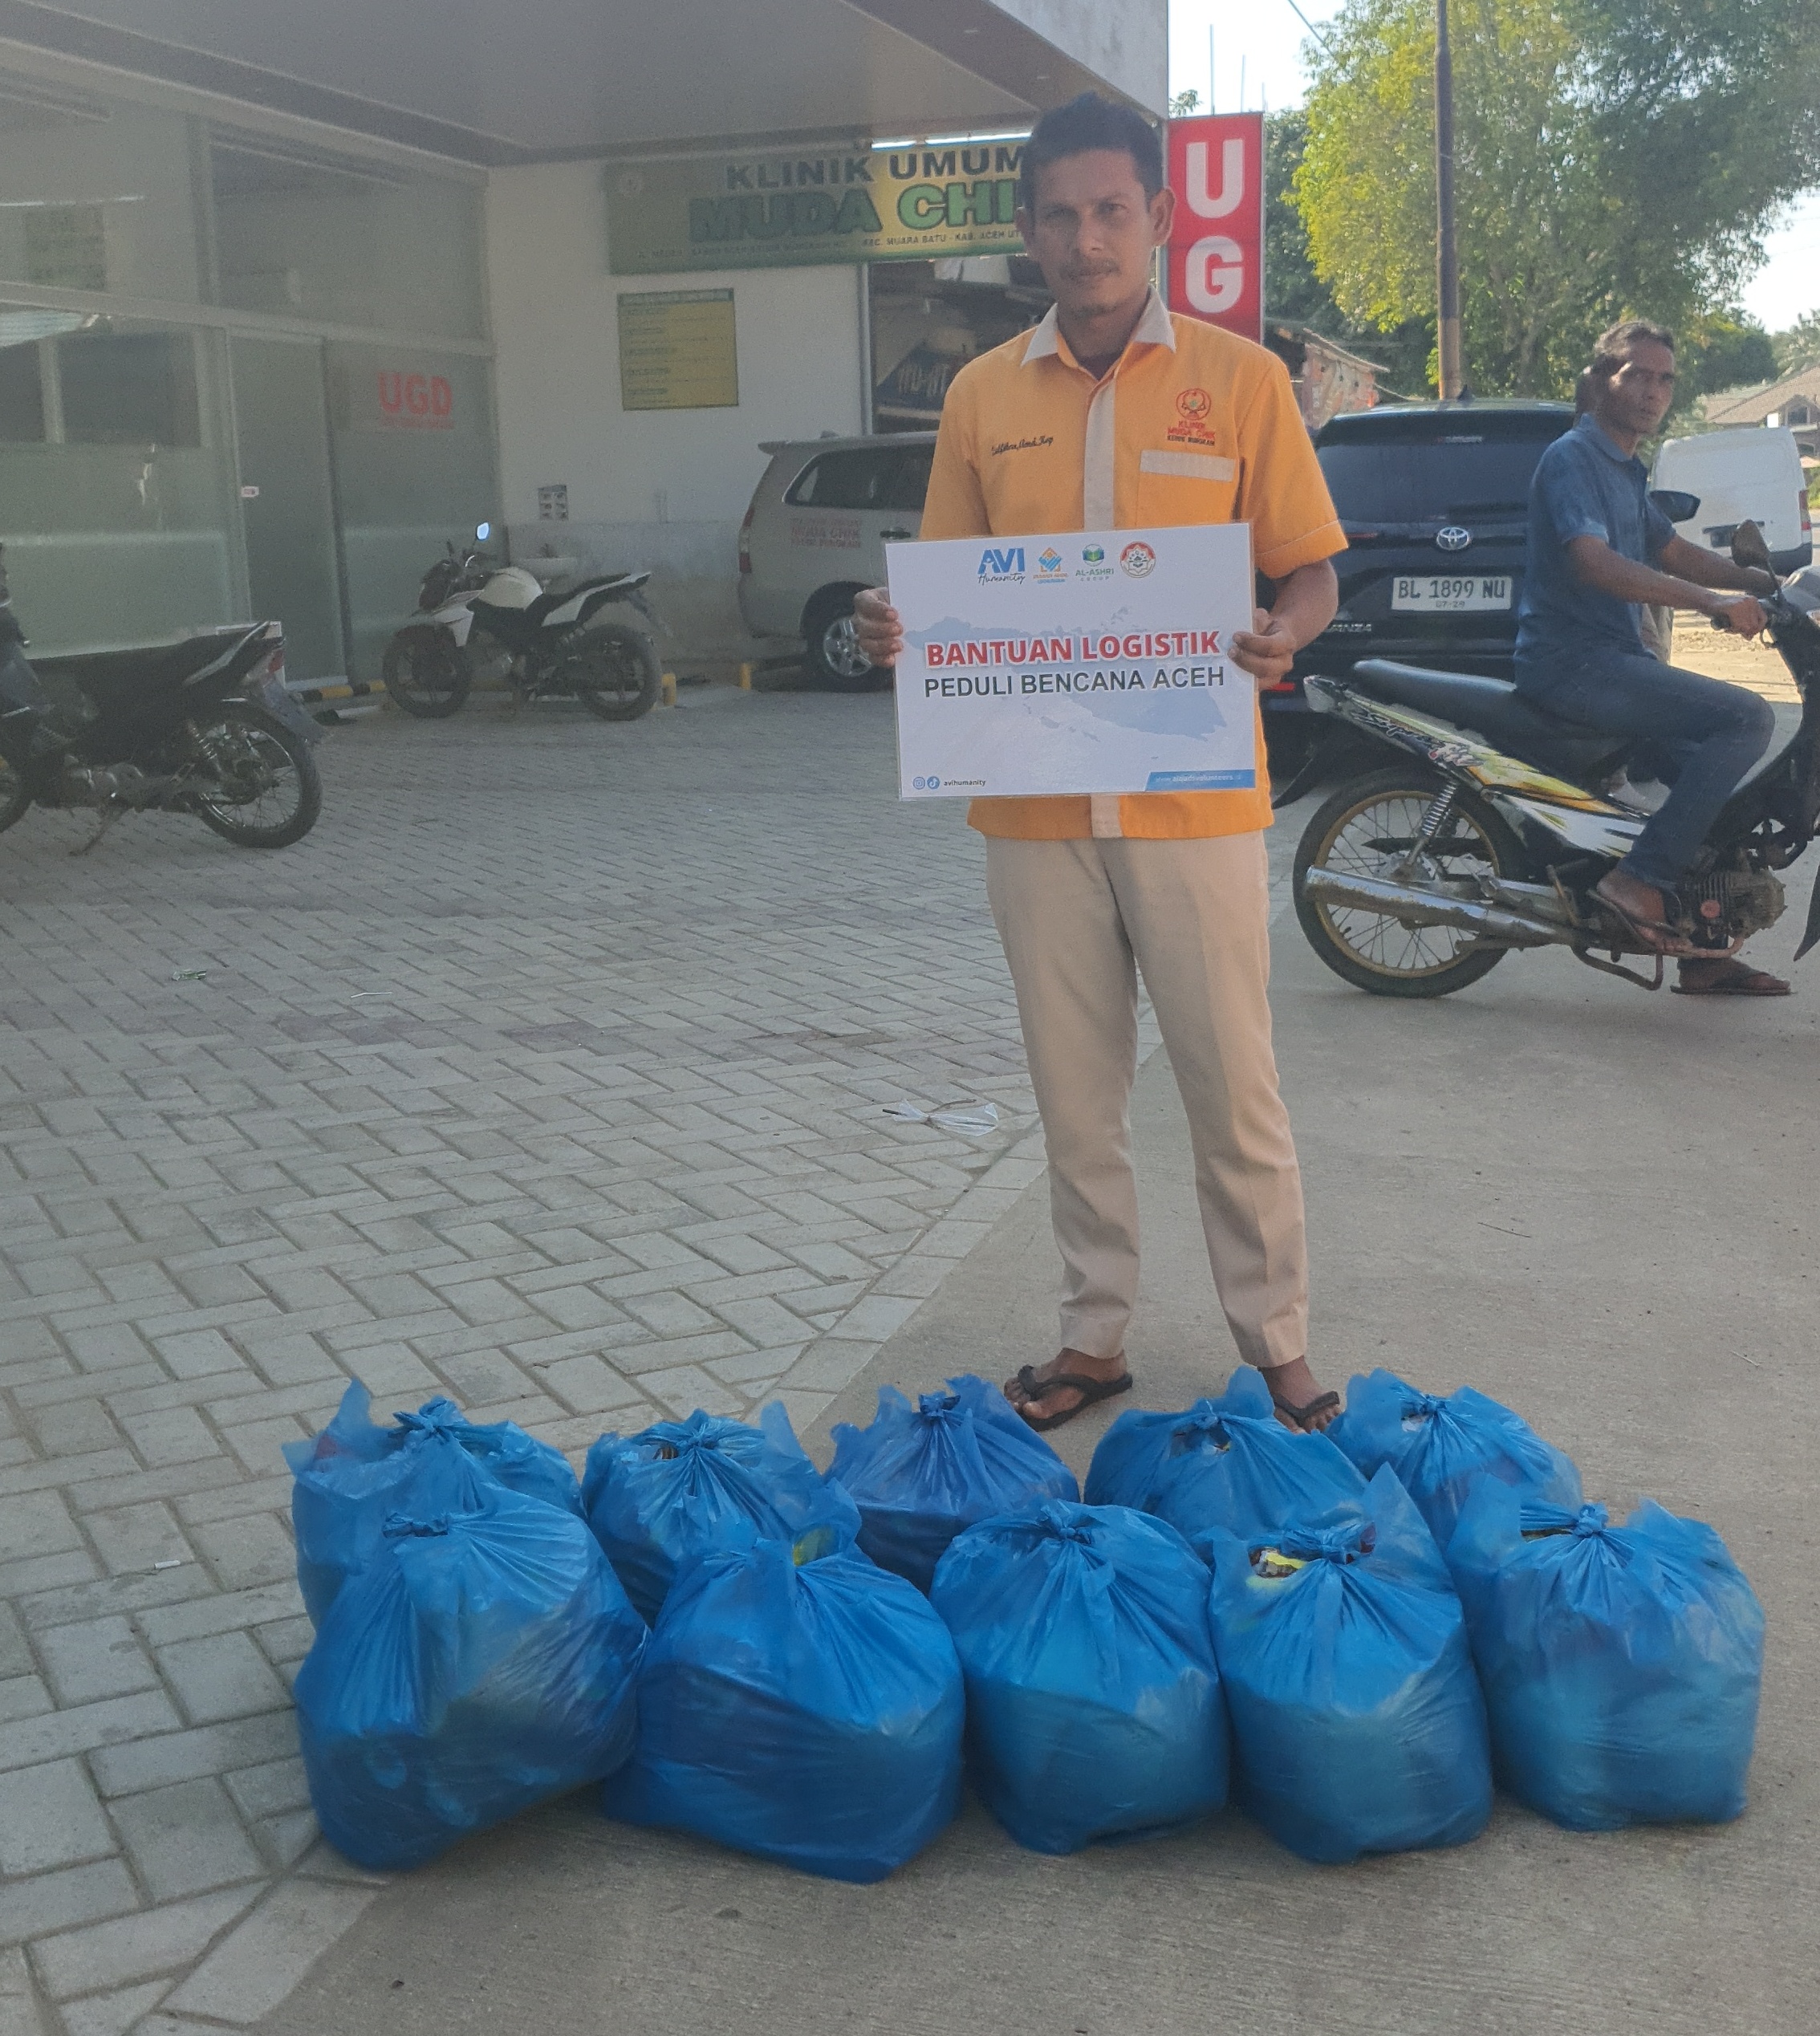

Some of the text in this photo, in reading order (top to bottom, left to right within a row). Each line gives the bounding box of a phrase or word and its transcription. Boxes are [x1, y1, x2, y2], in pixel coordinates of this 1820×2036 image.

[726, 145, 1025, 189] KLINIK UMUM
[689, 177, 1016, 242] MUDA CHI
[922, 234, 946, 243] BATU
[1008, 230, 1024, 238] UT
[377, 372, 453, 416] UGD
[977, 547, 1026, 574] AVI
[1075, 568, 1114, 576] AL-ASHRI
[978, 572, 1026, 586] Humanity
[1398, 579, 1505, 599] BL 1899 NU
[926, 631, 1221, 667] BANTUAN LOGISTIK
[924, 666, 1224, 697] PEDULI BENCANA ACEH
